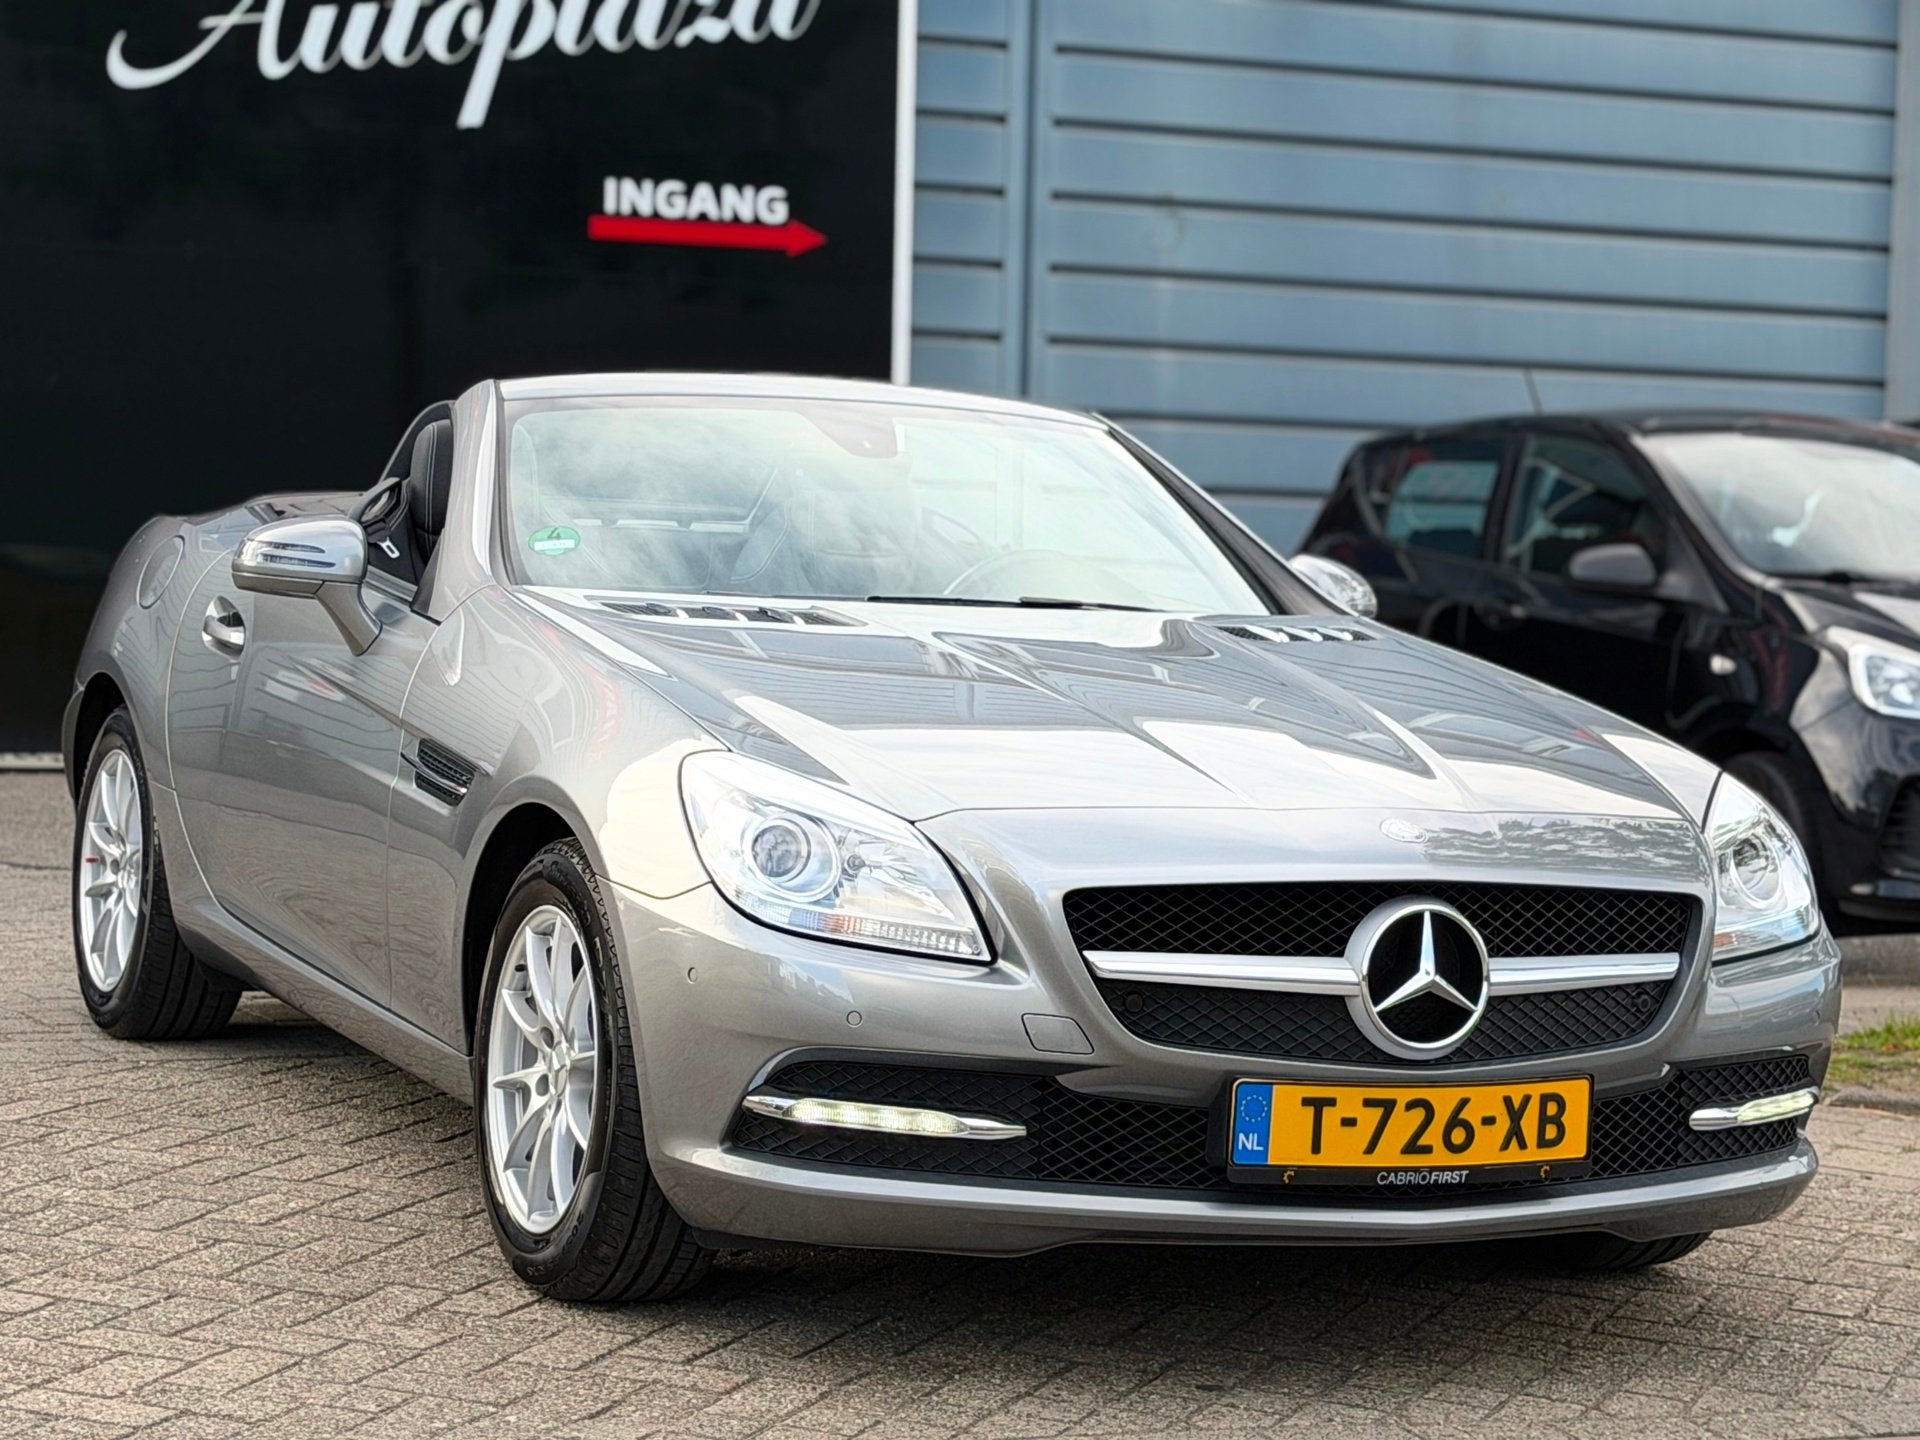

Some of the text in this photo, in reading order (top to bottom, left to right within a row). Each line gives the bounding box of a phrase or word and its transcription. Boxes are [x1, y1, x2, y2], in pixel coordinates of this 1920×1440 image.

[603, 176, 790, 226] INGANG
[1238, 1132, 1264, 1151] NL
[1301, 1092, 1566, 1156] T-726-XB
